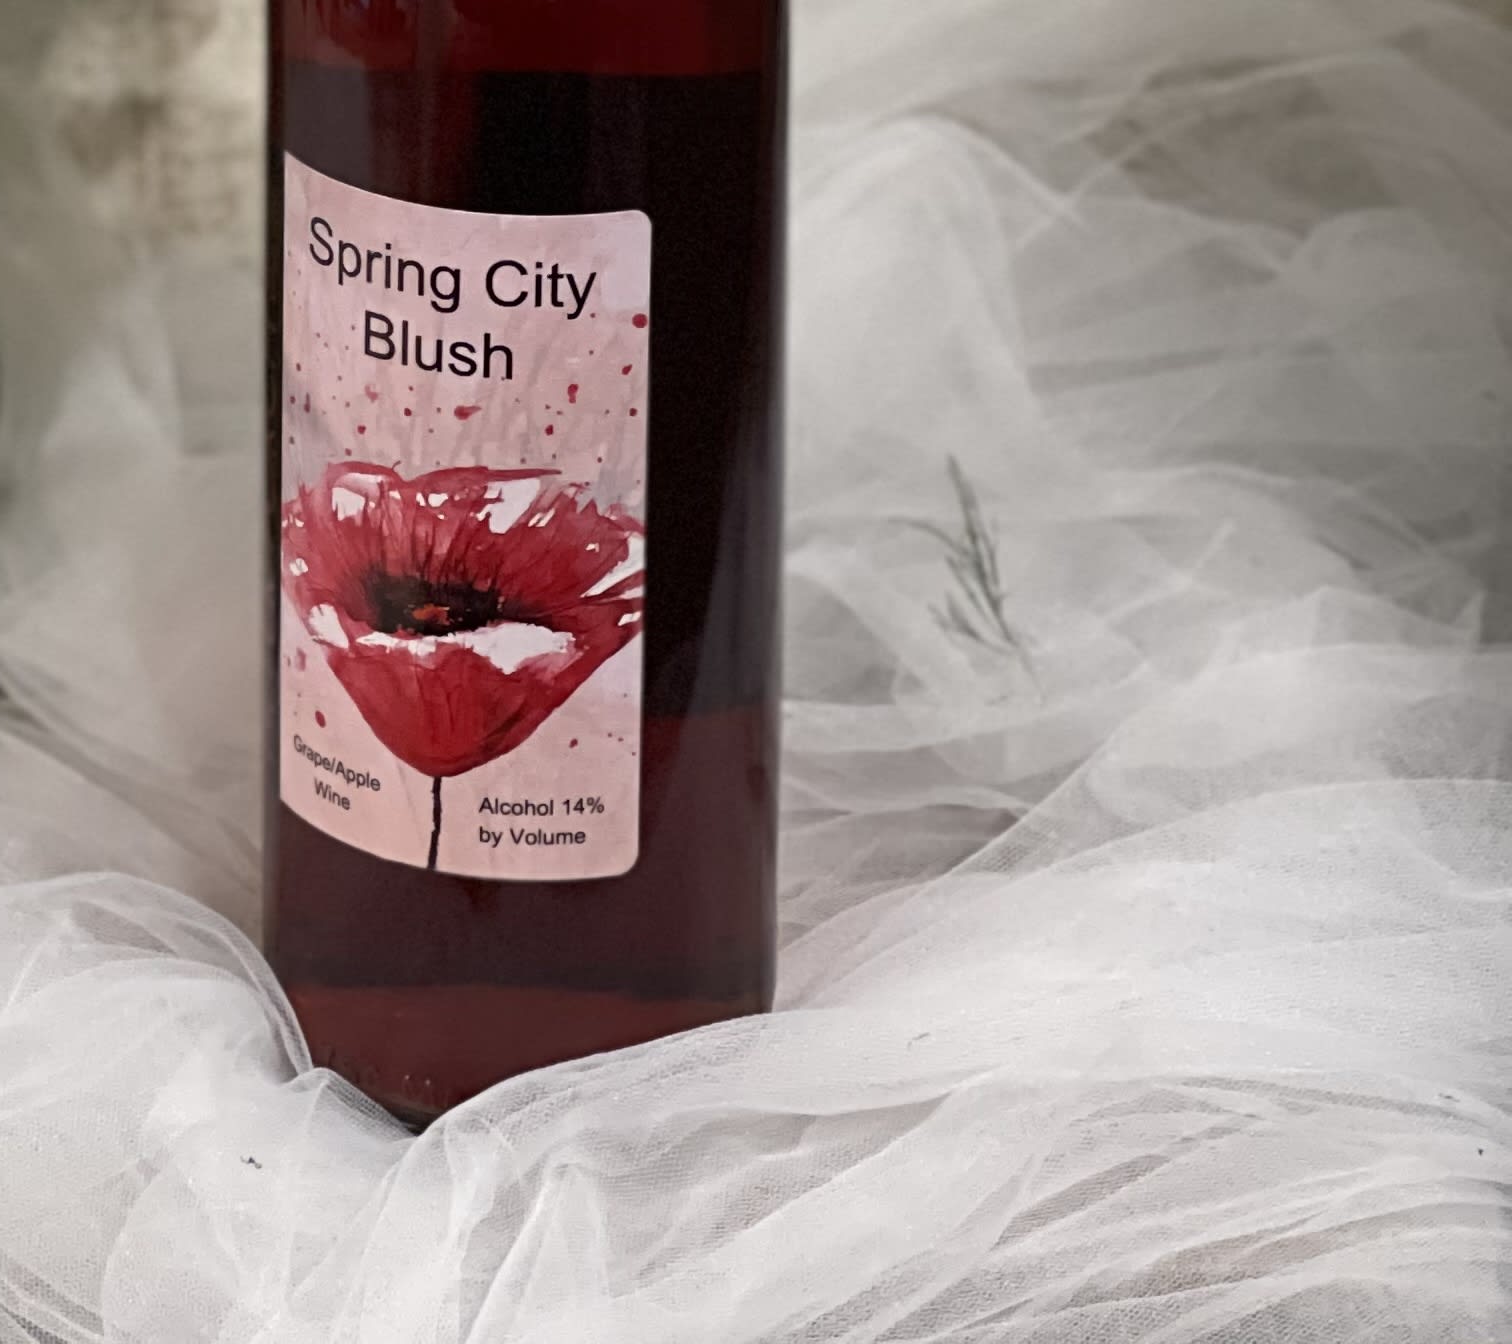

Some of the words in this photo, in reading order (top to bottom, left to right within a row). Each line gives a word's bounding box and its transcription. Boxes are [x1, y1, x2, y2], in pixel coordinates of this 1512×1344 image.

[309, 216, 462, 314] Spring
[485, 259, 597, 320] City
[364, 309, 514, 381] Blush
[292, 734, 381, 793] Grape/Apple
[313, 777, 351, 811] Wine
[478, 796, 554, 817] Alcohol
[563, 796, 605, 815] 14%
[479, 825, 503, 849] by
[510, 827, 587, 847] Volume
